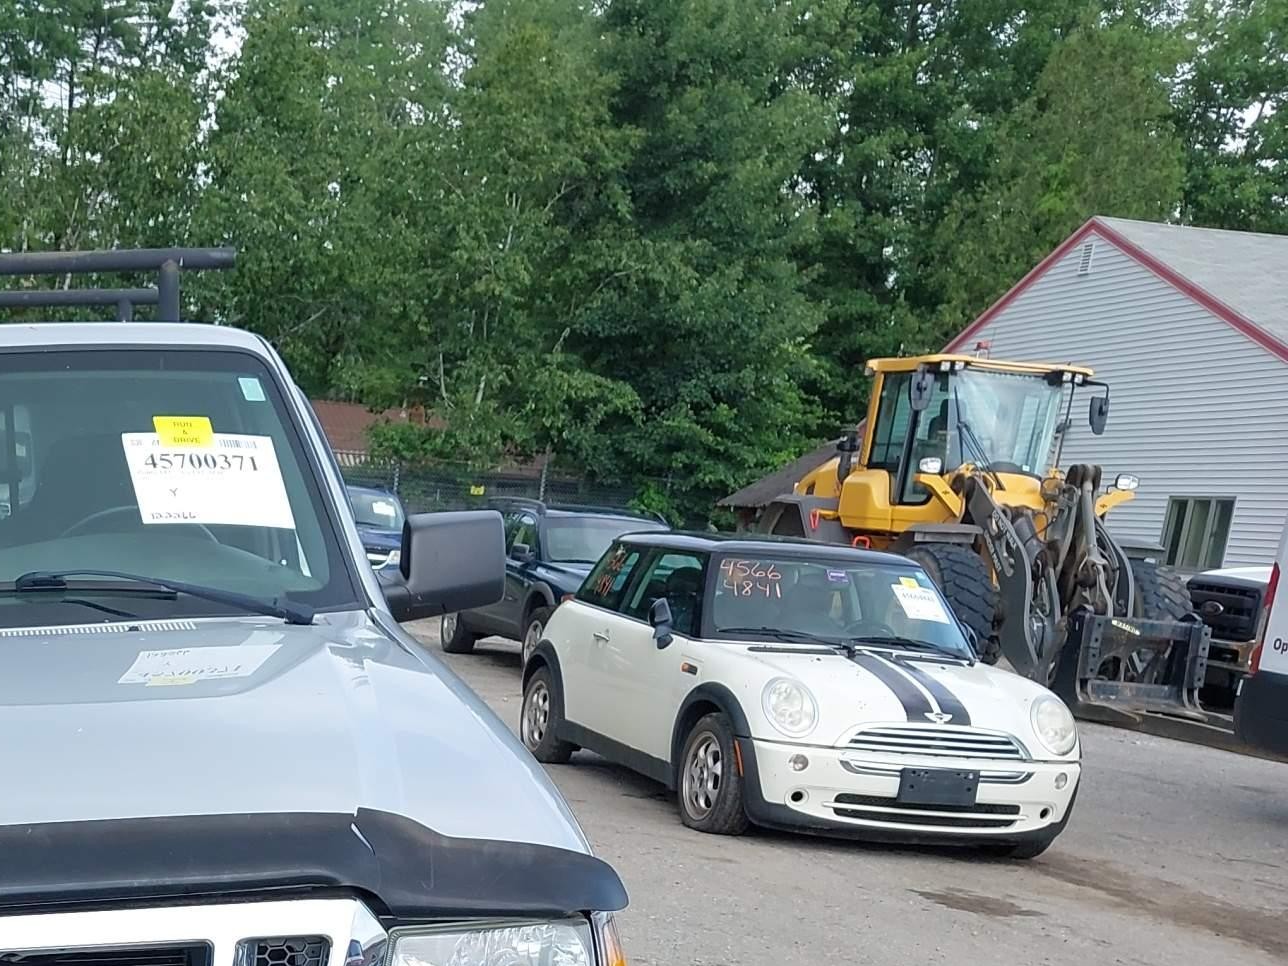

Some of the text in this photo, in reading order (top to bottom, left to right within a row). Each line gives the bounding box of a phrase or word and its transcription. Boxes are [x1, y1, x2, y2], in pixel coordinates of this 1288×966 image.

[144, 453, 258, 471] 45700371
[719, 559, 782, 580] 4566
[722, 579, 782, 599] 4841
